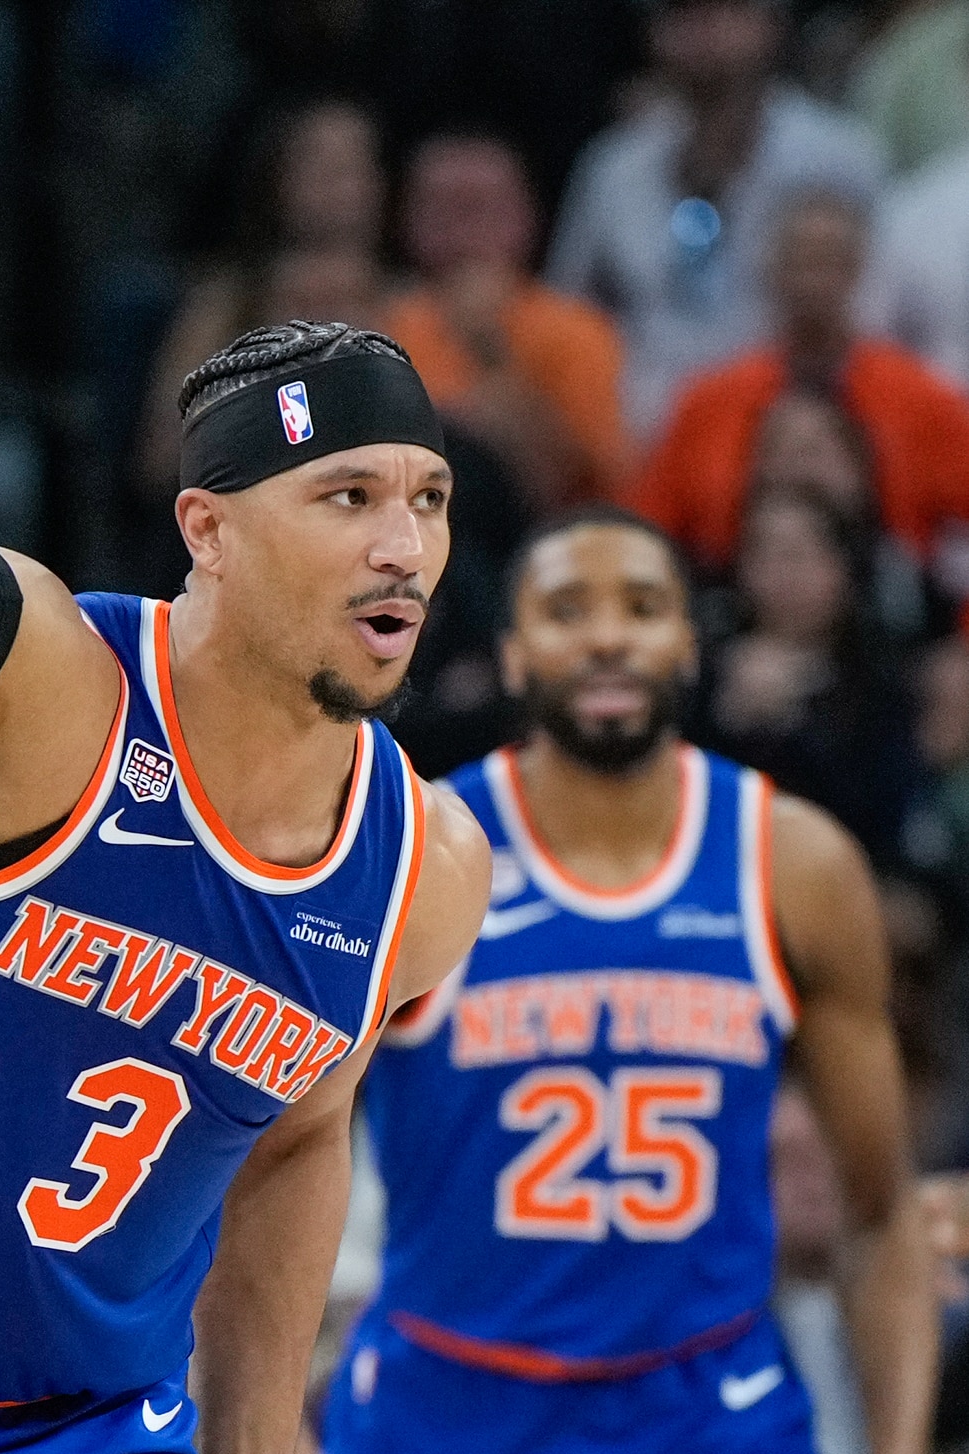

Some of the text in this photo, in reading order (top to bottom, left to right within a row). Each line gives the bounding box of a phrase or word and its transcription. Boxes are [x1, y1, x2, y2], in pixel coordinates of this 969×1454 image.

[125, 767, 166, 797] 250
[133, 747, 169, 775] USA
[290, 923, 372, 957] abu dhabi
[296, 911, 342, 930] experience
[170, 955, 353, 1102] YORK
[453, 969, 768, 1067] NEW YORK
[18, 1057, 191, 1252] 3
[497, 1068, 722, 1241] 25
